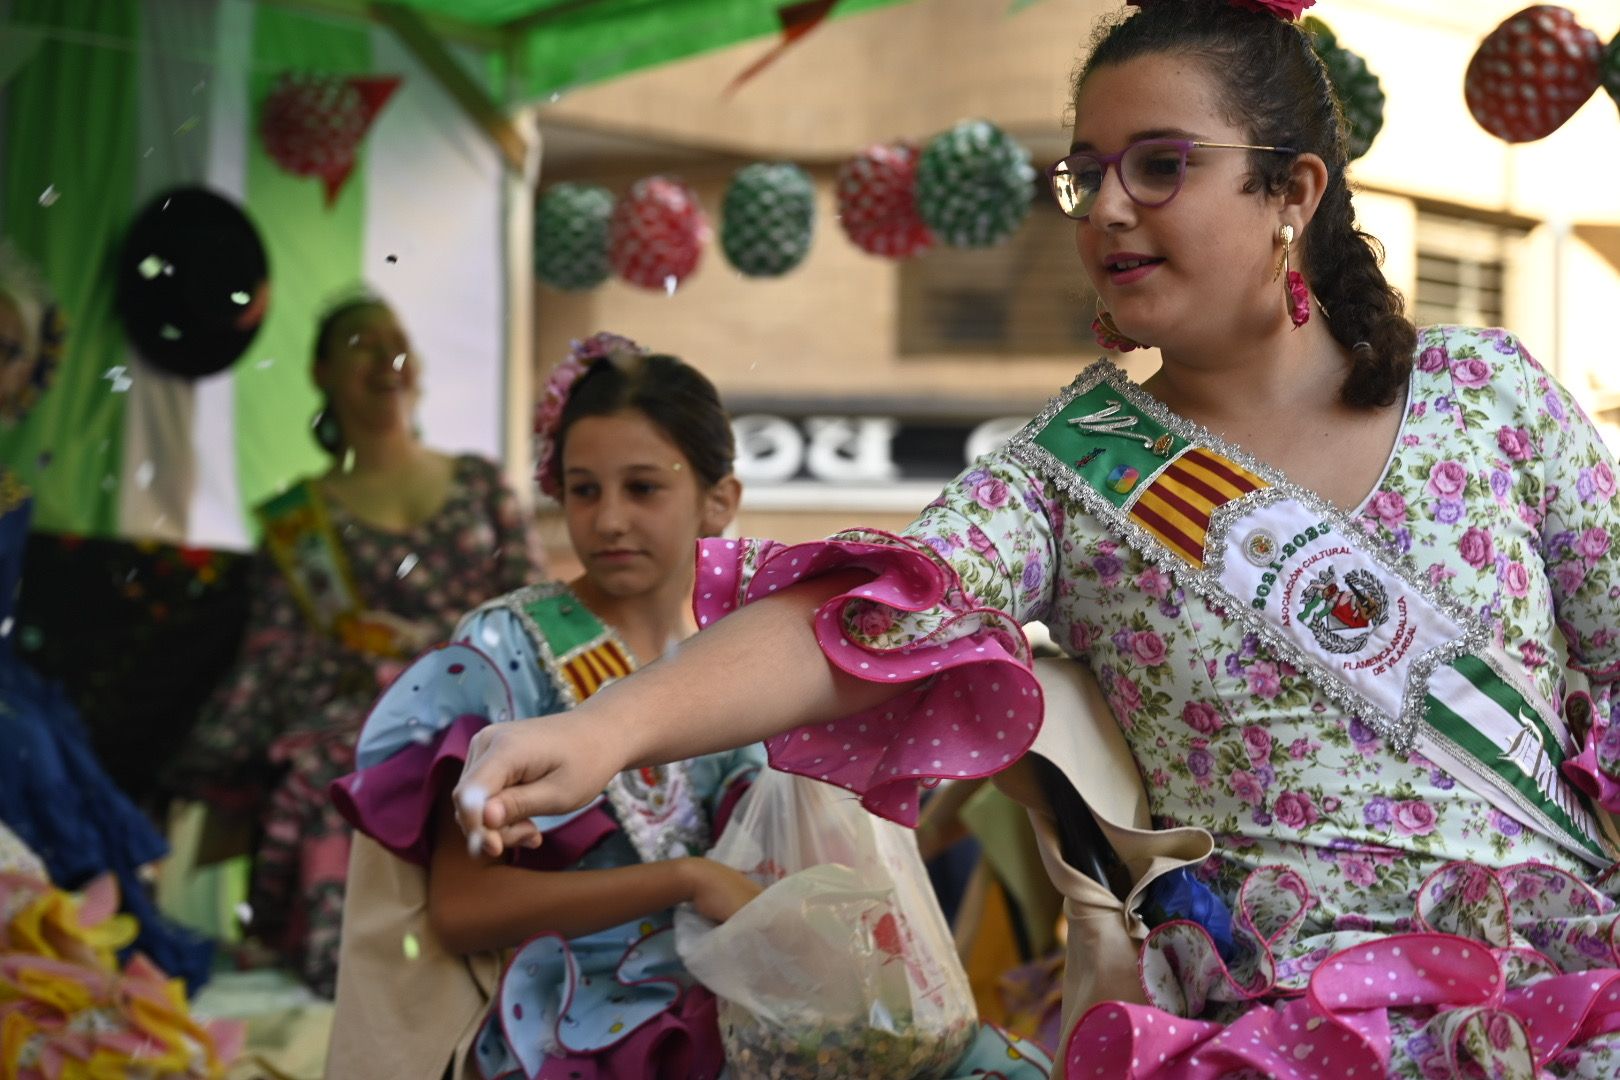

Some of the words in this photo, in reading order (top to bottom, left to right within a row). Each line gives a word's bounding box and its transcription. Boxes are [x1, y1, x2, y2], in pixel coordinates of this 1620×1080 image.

[1252, 522, 1331, 610] 2021-2023
[1302, 546, 1352, 568] CULTURAL
[1343, 647, 1393, 670] FLAMENCA
[1390, 596, 1407, 650] ANDALUZA
[1372, 664, 1386, 676] DE
